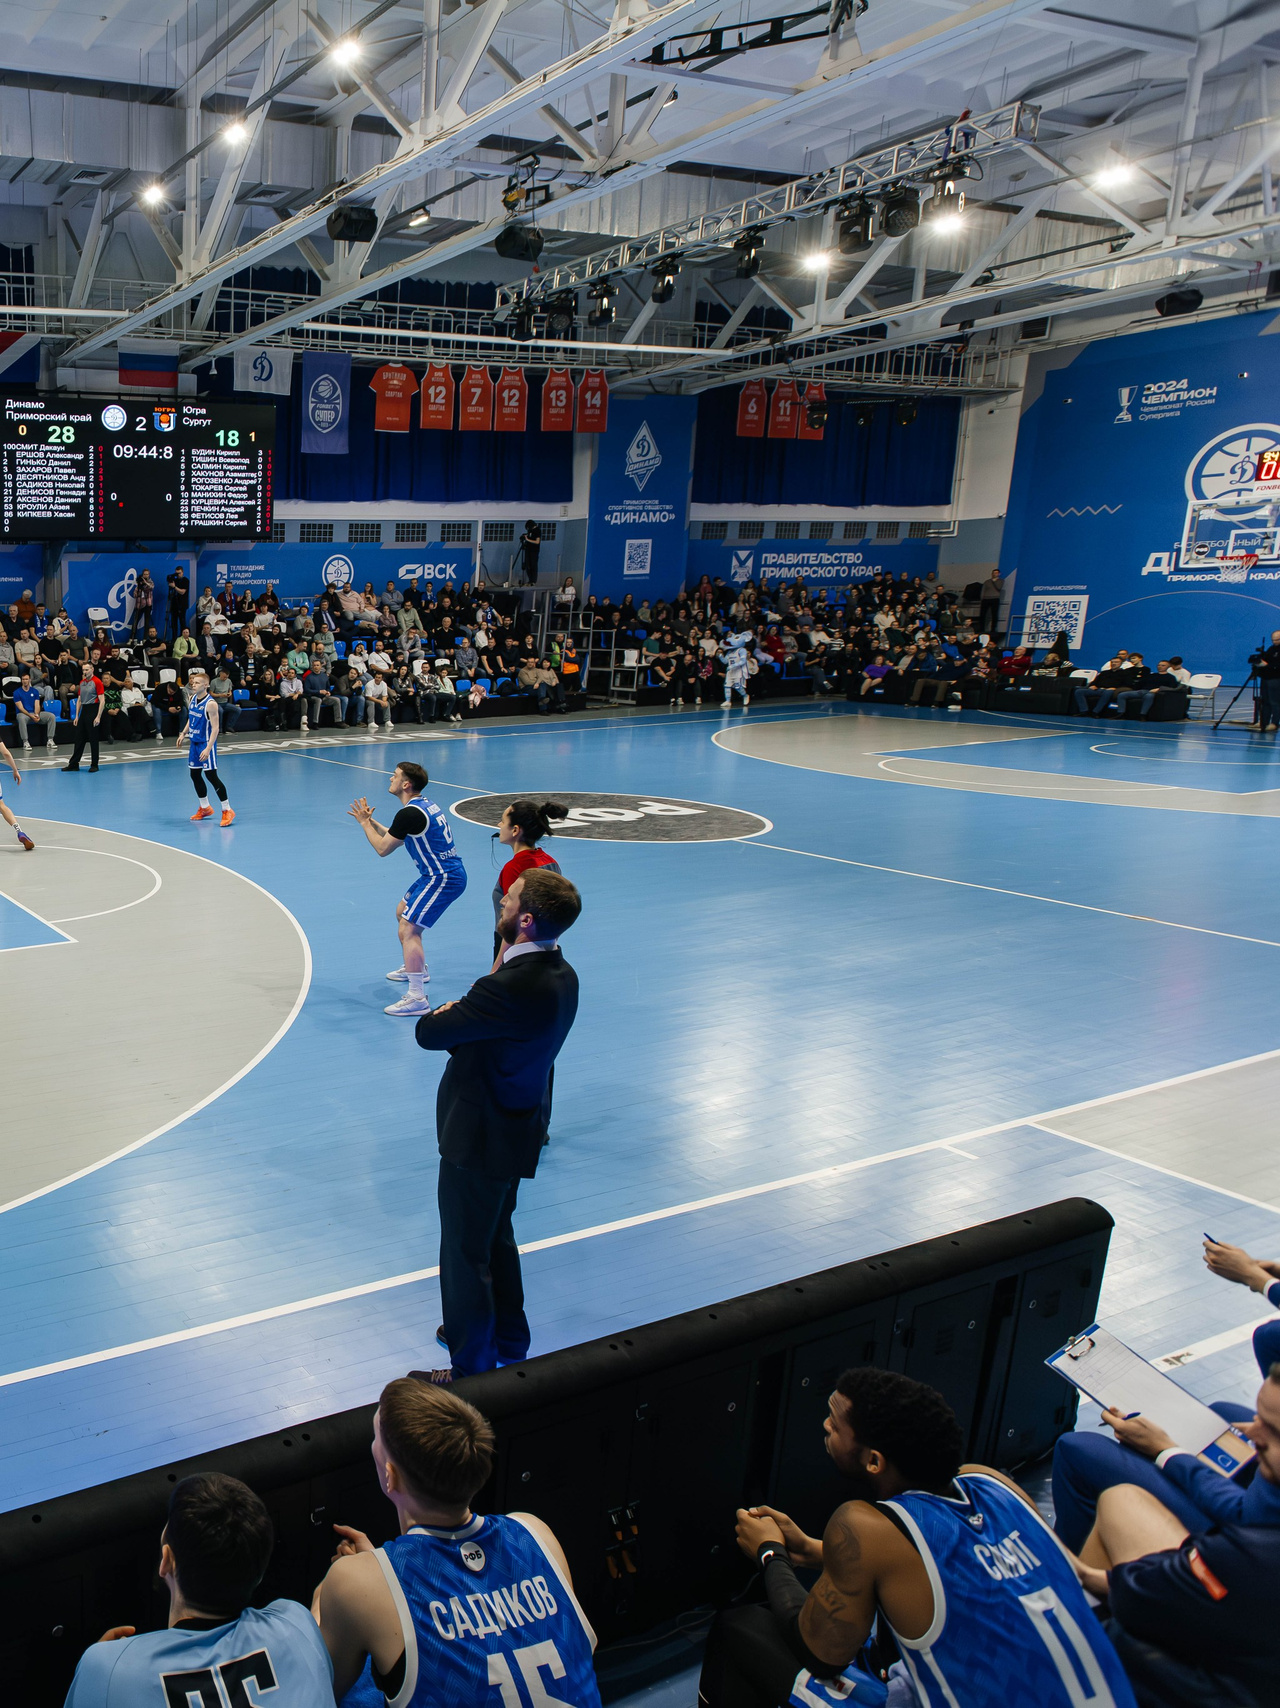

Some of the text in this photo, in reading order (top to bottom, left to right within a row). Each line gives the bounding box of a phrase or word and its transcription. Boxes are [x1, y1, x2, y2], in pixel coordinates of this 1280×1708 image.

[1143, 378, 1188, 394] 2024
[428, 385, 447, 404] 12
[470, 388, 482, 405] 7
[502, 388, 520, 406] 12
[549, 389, 567, 406] 13
[585, 391, 602, 407] 14
[1141, 386, 1218, 404] ЧЕМПИОН
[5, 399, 45, 409] Динамо
[183, 406, 206, 415] Югра
[747, 398, 757, 413] 6
[1140, 398, 1216, 412] Чемпионат России
[6, 411, 92, 422] Приморский край
[183, 417, 212, 427] Сургут
[314, 410, 336, 422] СУПЕР
[1138, 410, 1181, 421] Суперлига
[19, 425, 27, 435] 0
[136, 417, 146, 431] 2
[48, 425, 75, 443] 28
[215, 430, 239, 447] 18
[249, 432, 255, 441] 1
[46, 452, 84, 460] Александр
[113, 444, 173, 459] 09:44:8
[628, 455, 661, 472] ДИНАМО
[166, 493, 172, 501] 0
[604, 511, 676, 525] «ДИНАМО»
[761, 552, 863, 565] ПРАВИТЕЛЬСТВО
[423, 563, 457, 580] ВСК
[759, 565, 882, 579] ПРИМОРСКОГО КРАЯ
[463, 1547, 484, 1564] РФБ
[429, 1575, 559, 1642] САДИКОВ
